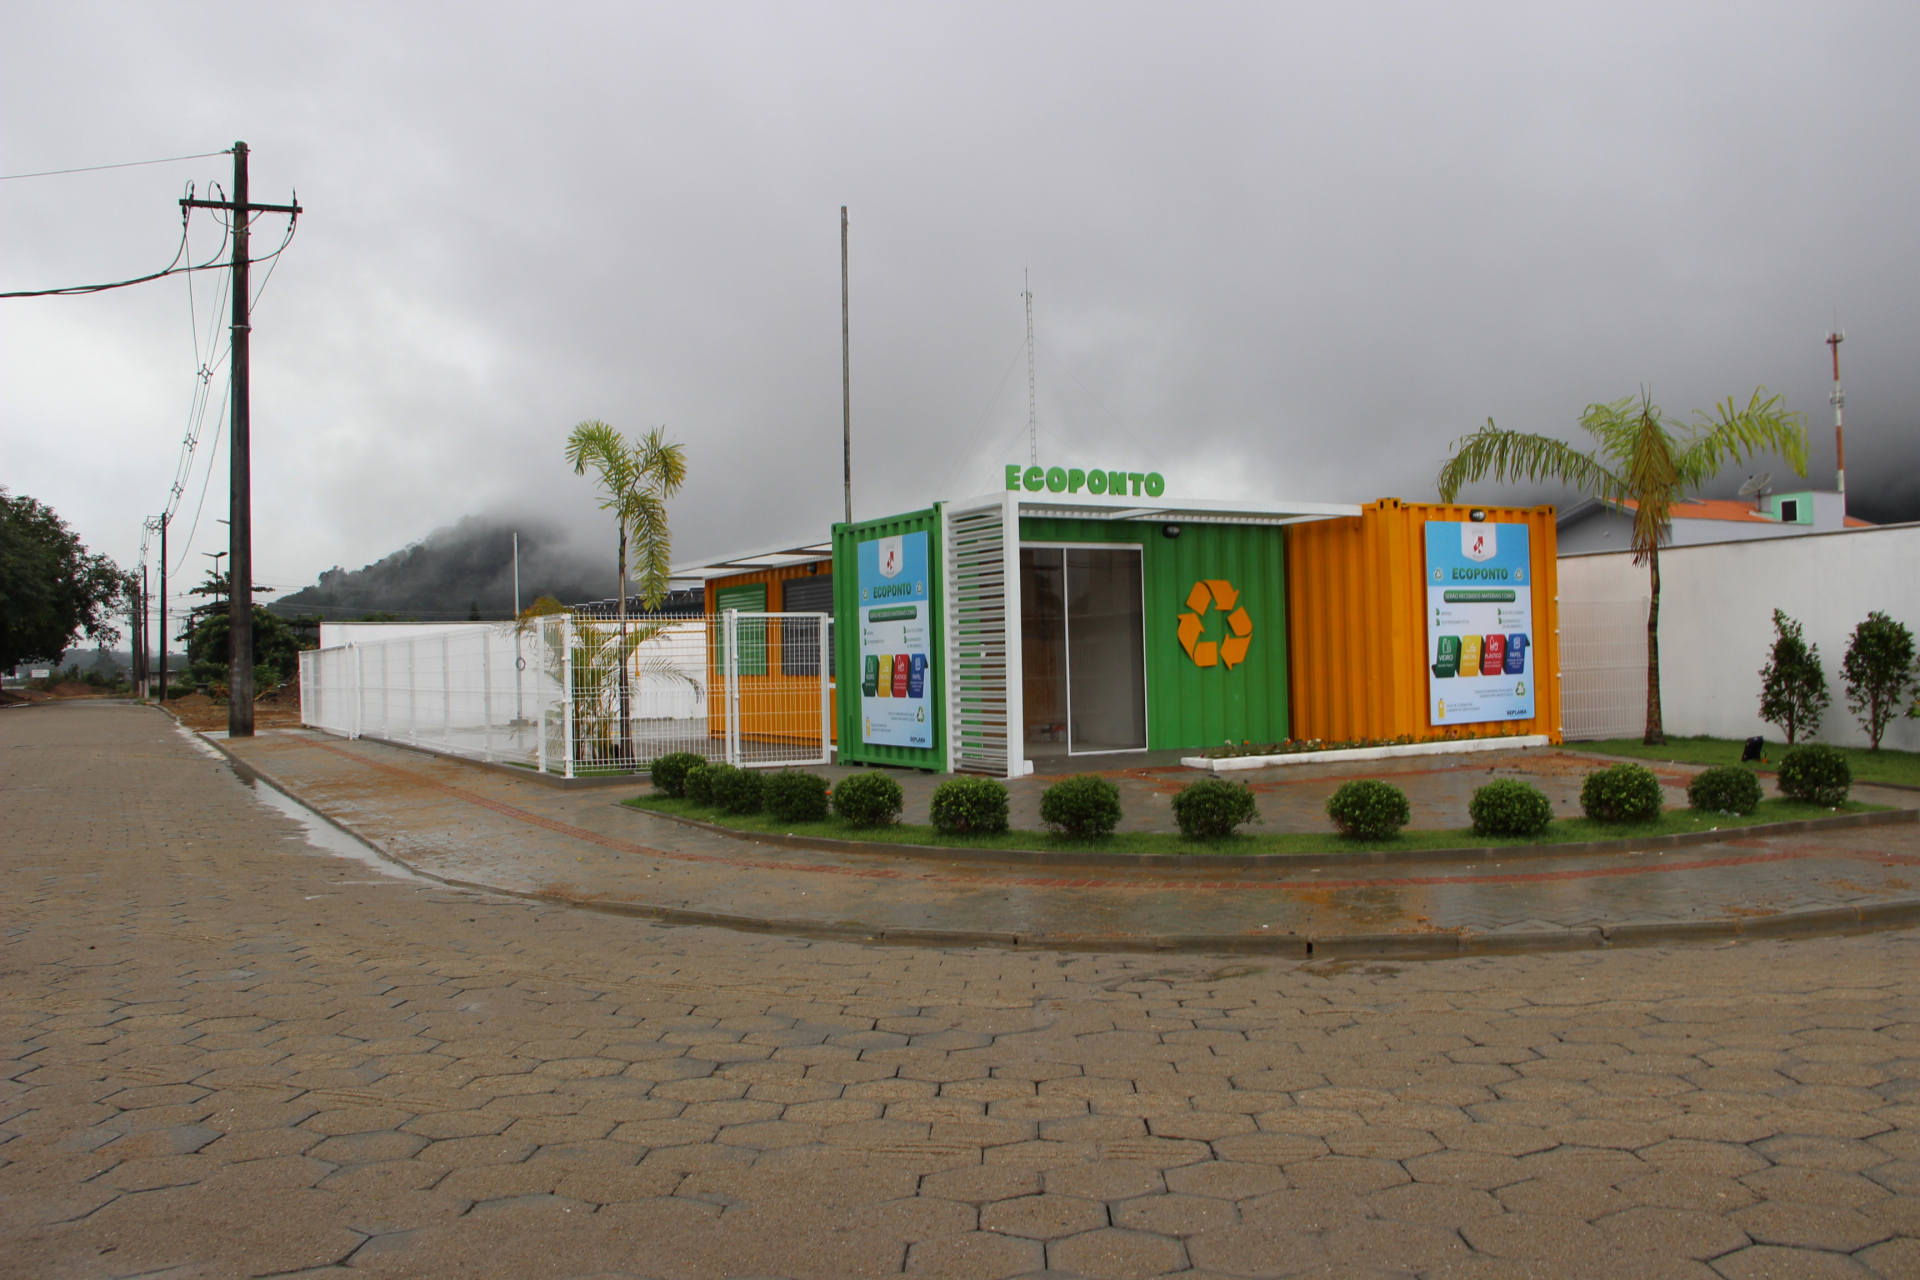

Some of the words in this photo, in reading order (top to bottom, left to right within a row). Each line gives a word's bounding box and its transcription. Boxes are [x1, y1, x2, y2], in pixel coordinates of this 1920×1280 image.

[1005, 464, 1165, 498] ECOPONTO
[1452, 567, 1508, 580] ECOPONTO
[873, 582, 912, 599] ECOPONTO
